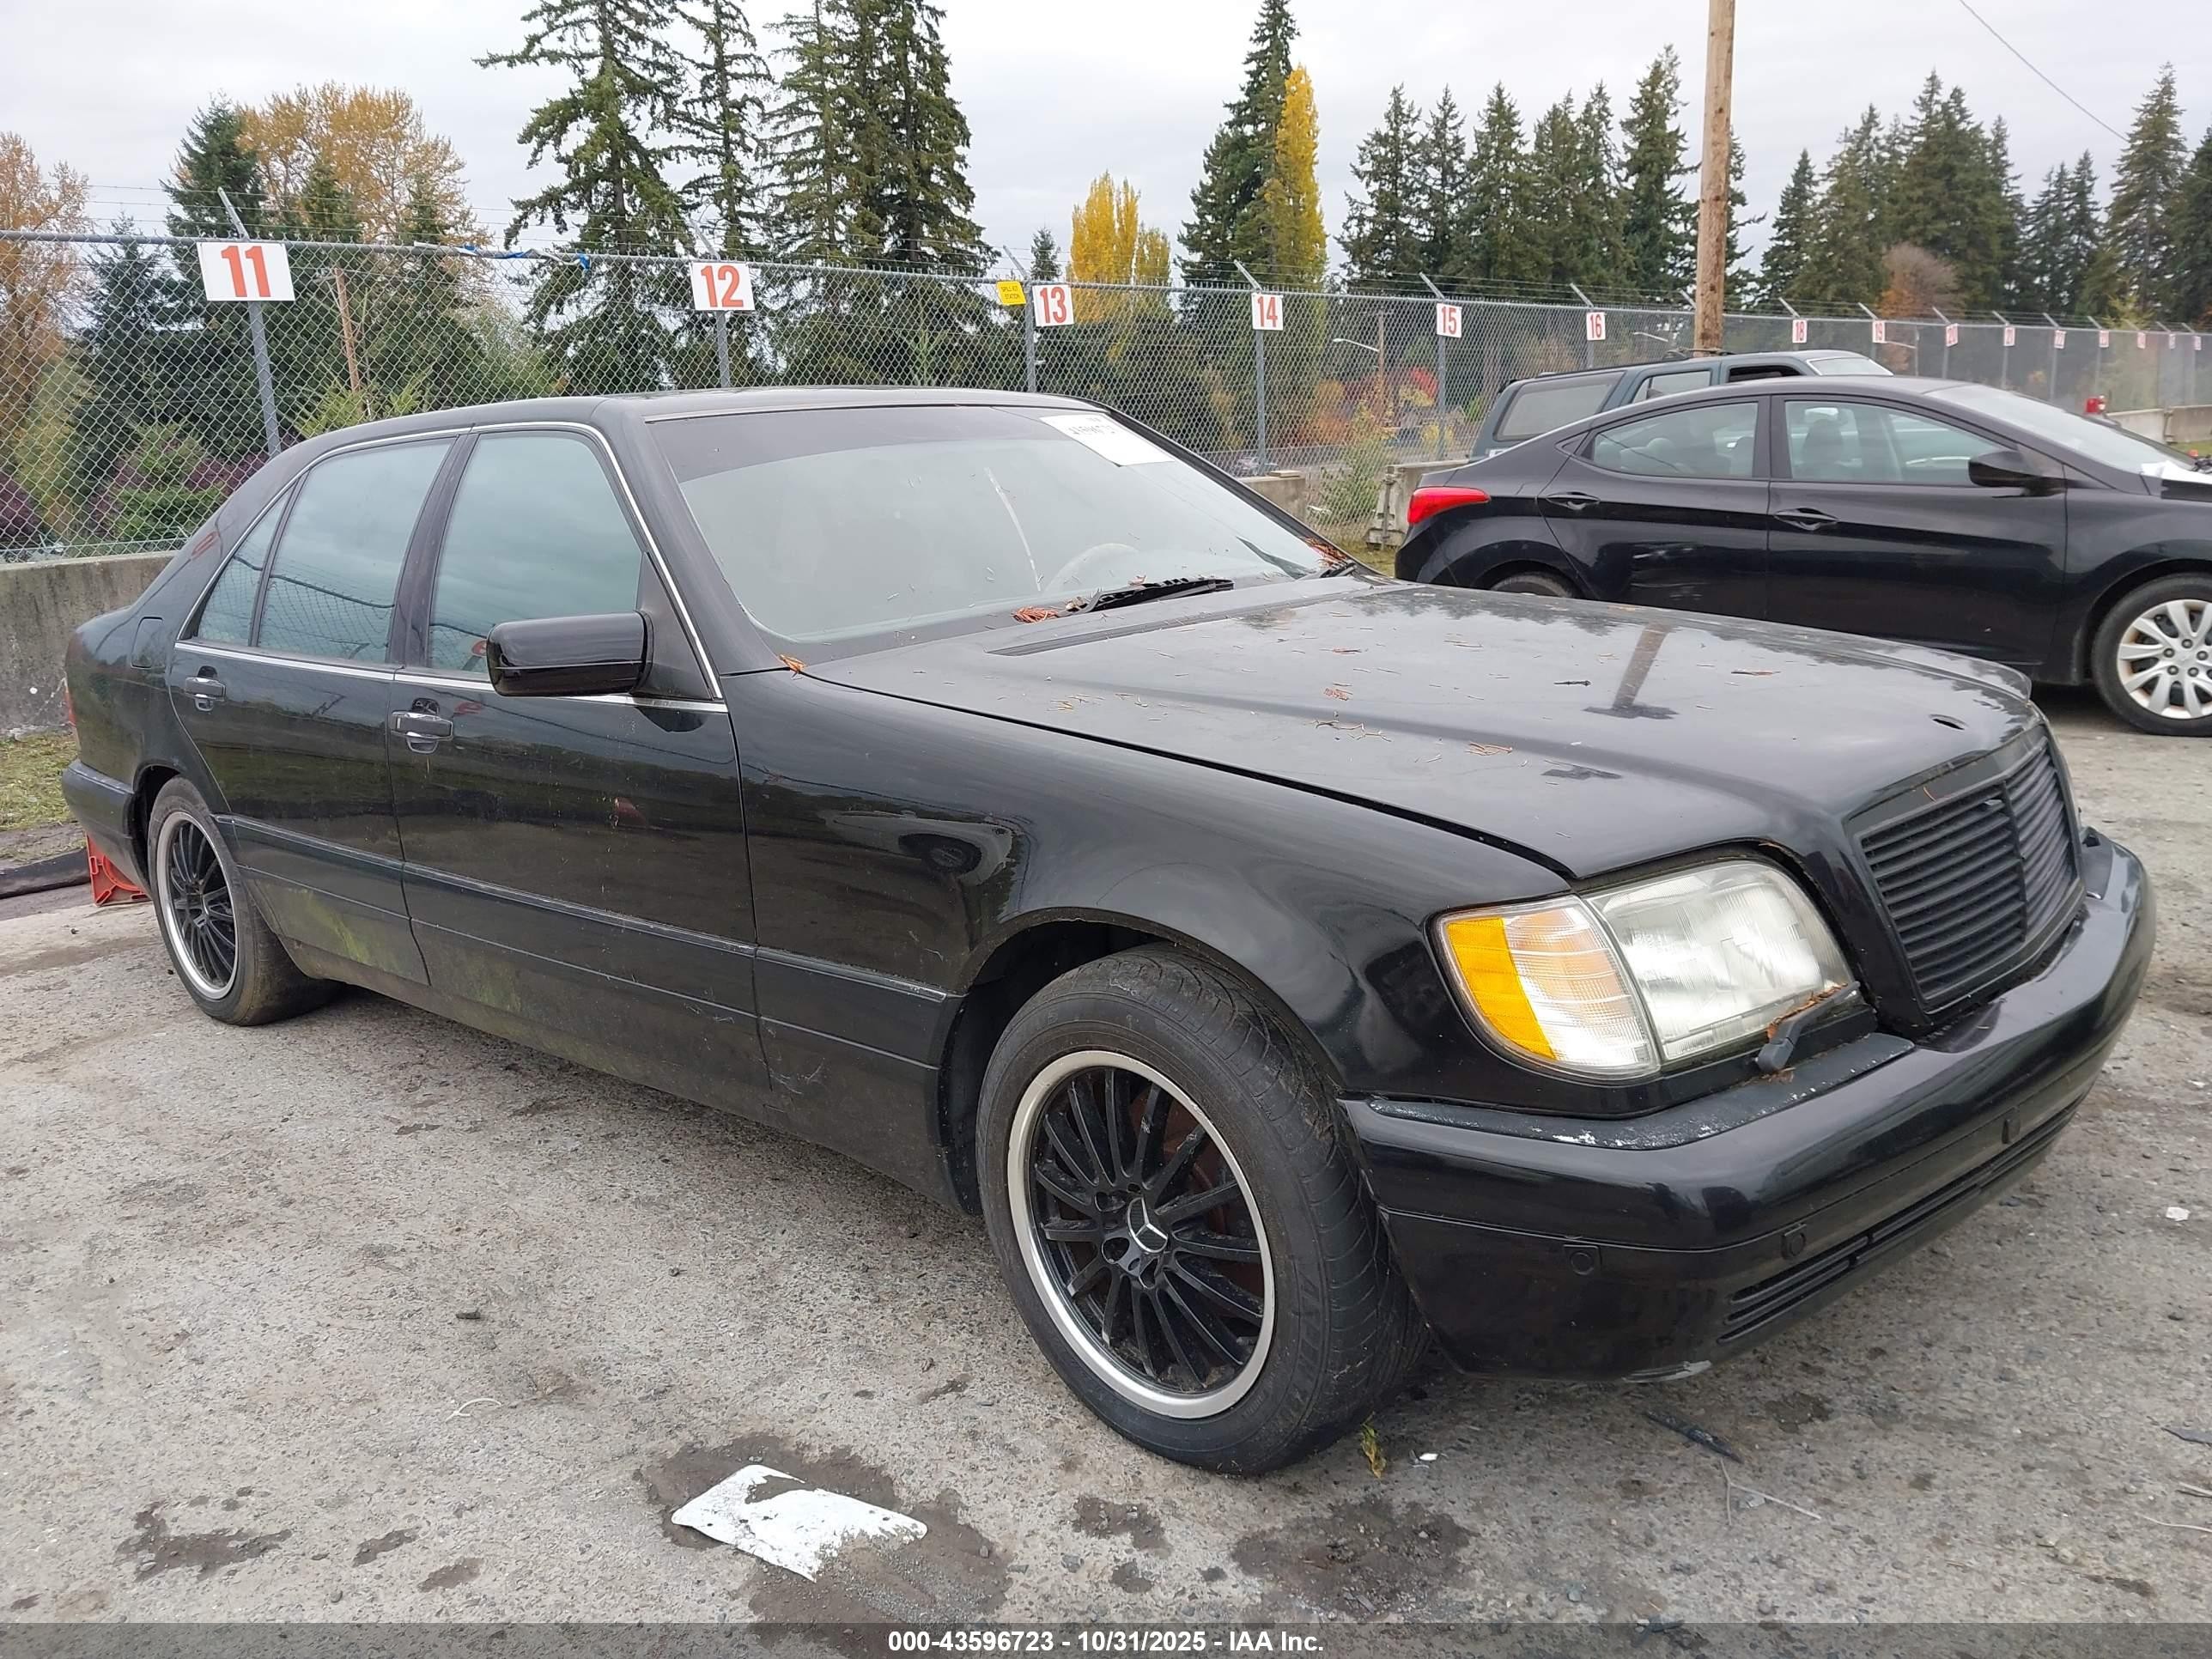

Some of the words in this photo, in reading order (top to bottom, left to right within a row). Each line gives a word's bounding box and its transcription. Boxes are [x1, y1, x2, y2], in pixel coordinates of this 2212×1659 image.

[221, 246, 271, 298] 11
[700, 264, 744, 308] 12
[1040, 286, 1067, 324] 13
[1256, 295, 1278, 325] 14
[1442, 306, 1457, 335] 15
[1590, 313, 1602, 339] 16
[1796, 321, 1805, 341] 18
